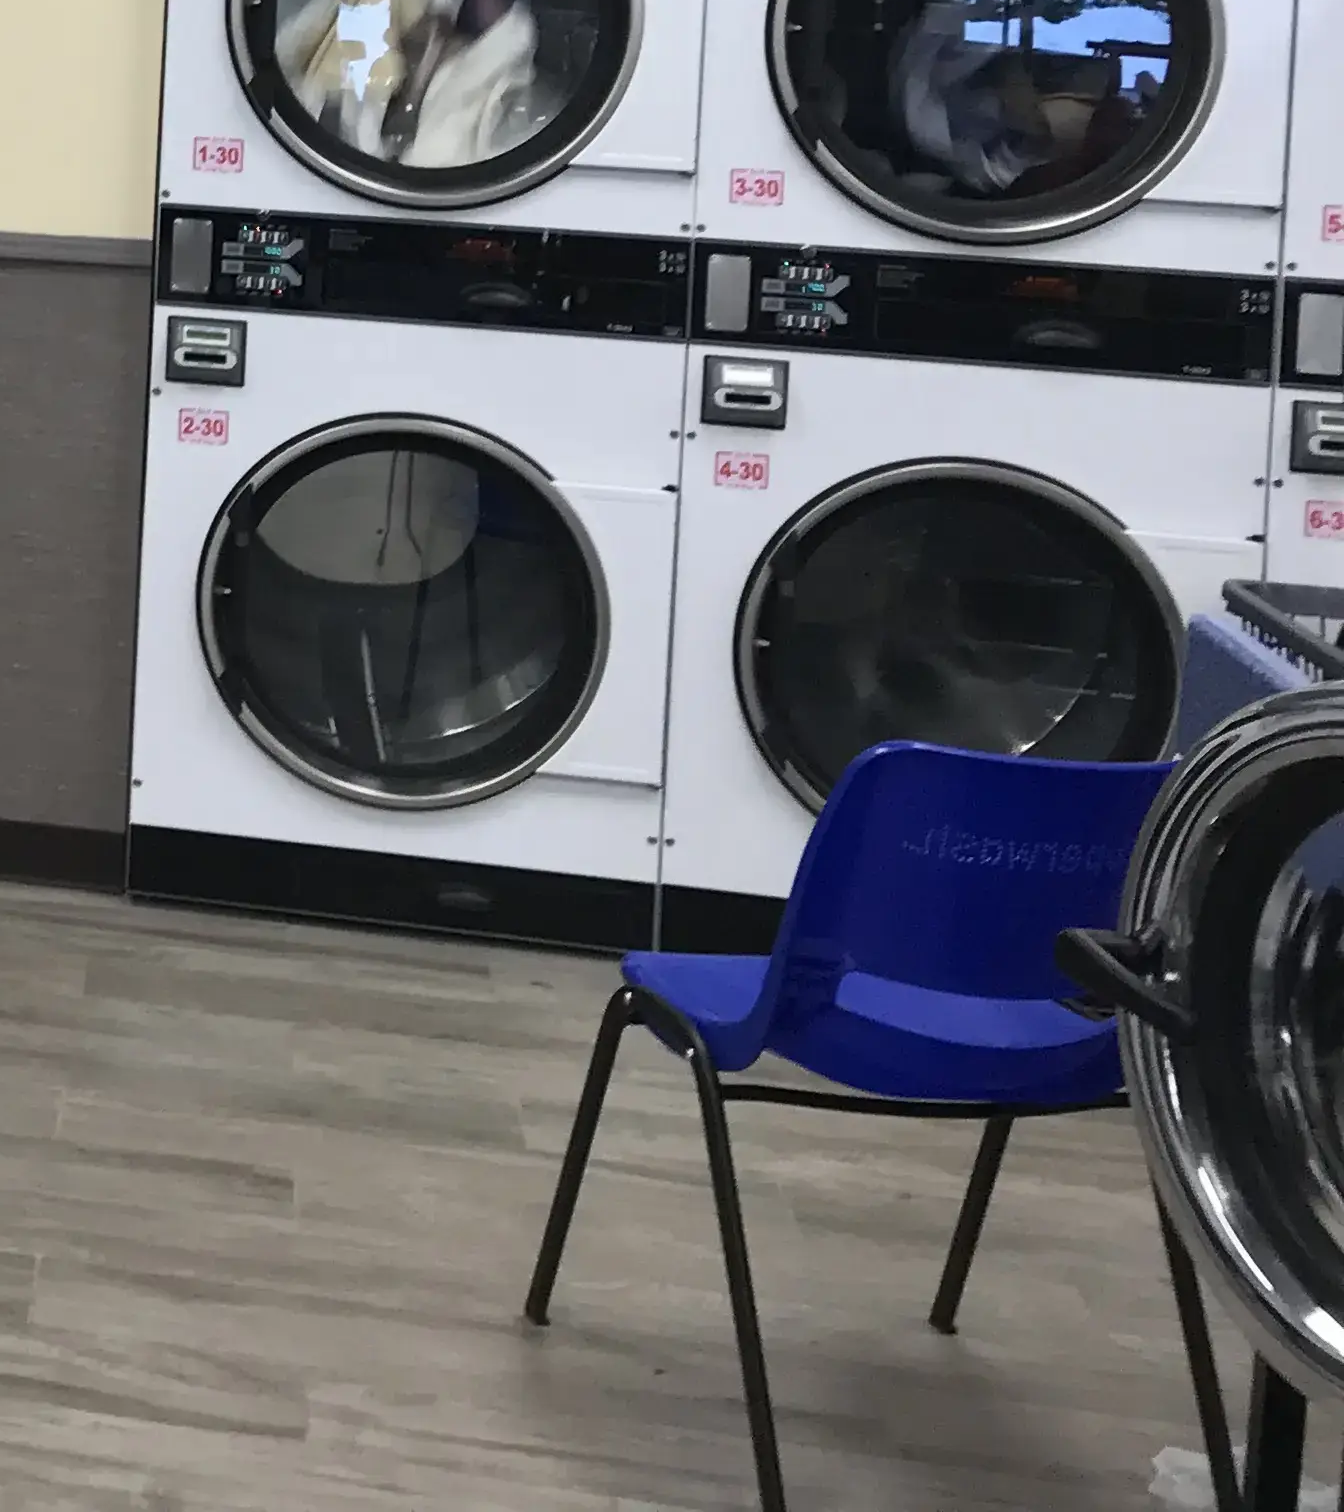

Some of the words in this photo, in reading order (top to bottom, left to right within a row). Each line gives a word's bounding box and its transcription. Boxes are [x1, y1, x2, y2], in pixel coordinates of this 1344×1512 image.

[199, 145, 240, 166] 1-30
[734, 178, 780, 198] 3-30
[182, 418, 226, 437] 2-30
[719, 461, 765, 481] 4-30
[1309, 509, 1344, 530] 6-3
